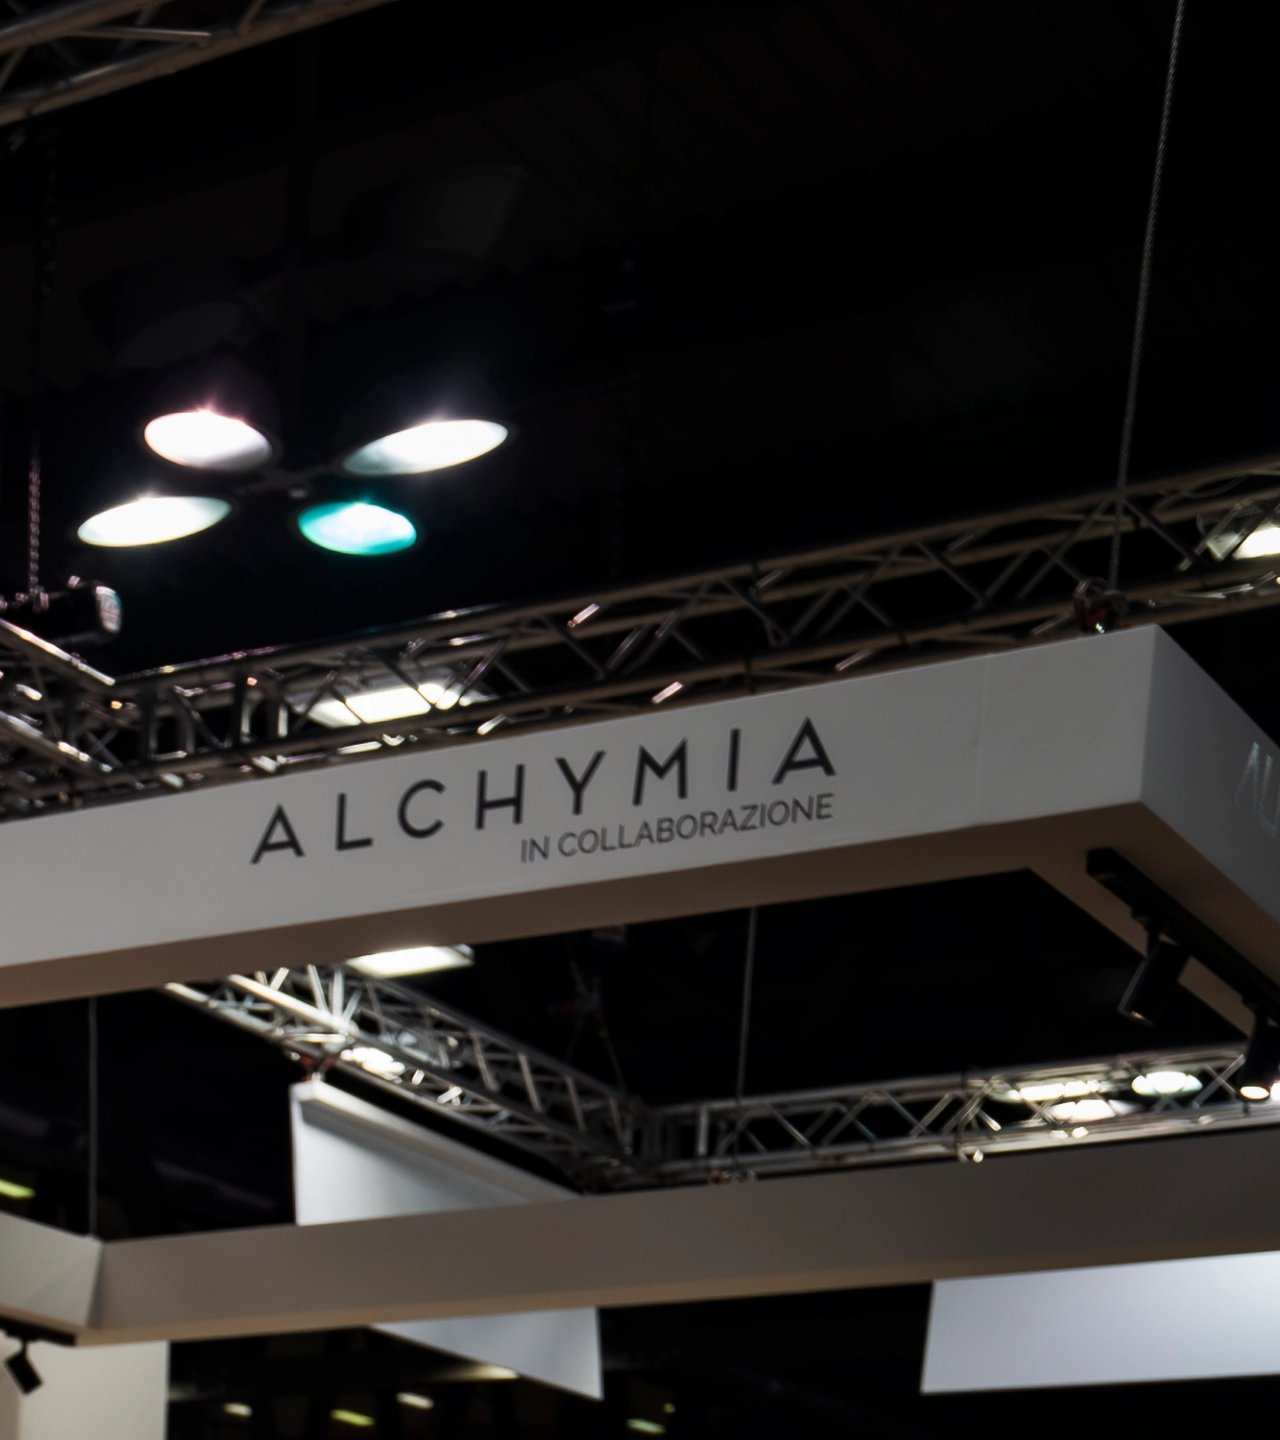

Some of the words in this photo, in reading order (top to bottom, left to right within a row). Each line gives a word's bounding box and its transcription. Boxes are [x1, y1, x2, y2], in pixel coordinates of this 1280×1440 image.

[250, 716, 837, 864] ALCHYMIA
[520, 835, 550, 864] IN
[557, 792, 836, 858] COLLABORAZIONE
